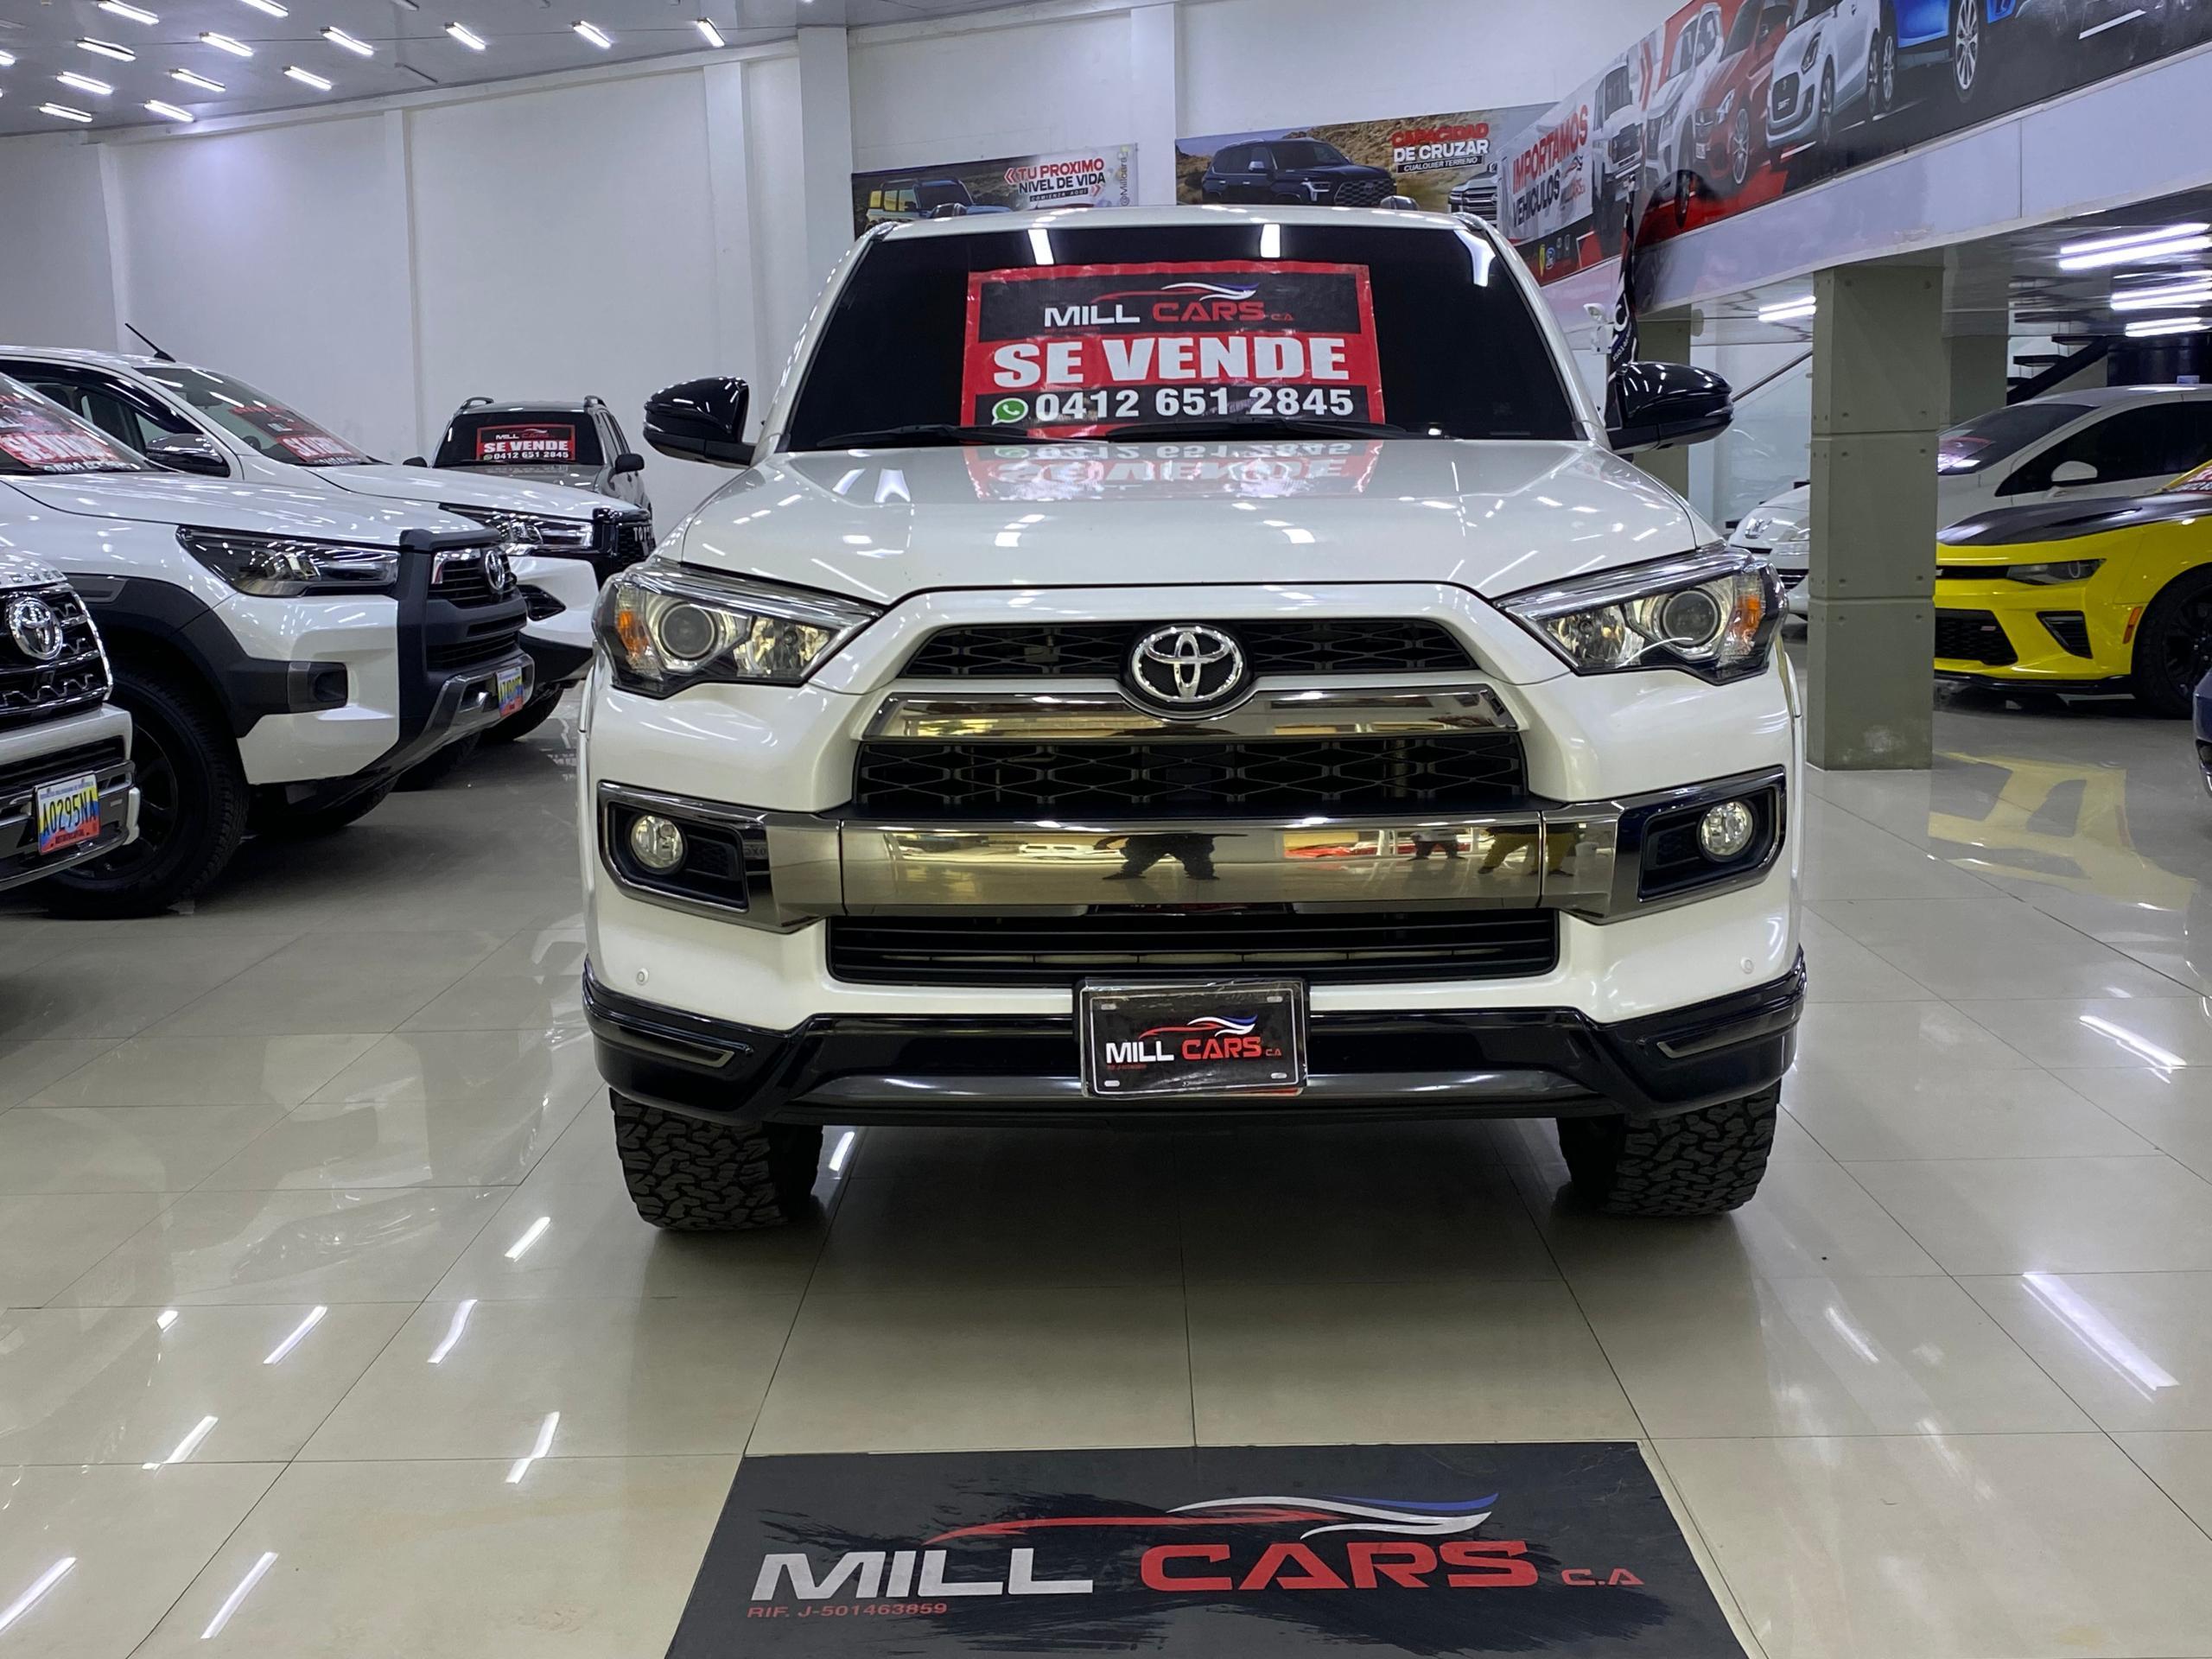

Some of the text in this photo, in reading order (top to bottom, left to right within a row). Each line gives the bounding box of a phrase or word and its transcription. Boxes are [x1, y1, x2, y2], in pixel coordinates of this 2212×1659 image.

[1391, 123, 1489, 147] CAPACIDAD
[1394, 139, 1488, 162] DE CRUZAR
[1513, 105, 1588, 194] IMPORTAMOS
[1019, 158, 1104, 180] TU PROXIMO
[1403, 157, 1478, 172] CUALQUIER TERRENO
[1020, 172, 1105, 194] NIVEL DE VIDA
[1031, 192, 1065, 201] COMIENZA
[1513, 169, 1560, 228] VEHICULOS
[1045, 304, 1140, 327] MILL
[1153, 302, 1266, 321] CARS
[994, 337, 1350, 387] SE VENDE
[1036, 387, 1354, 422] 0412 651 2845
[484, 441, 569, 453] SE VENDE
[1106, 1040, 1174, 1064] MILL
[1182, 1037, 1262, 1060] CARS
[751, 1541, 1644, 1601] MILL CARS C.A
[747, 1603, 947, 1618] RIF. J-501463859
